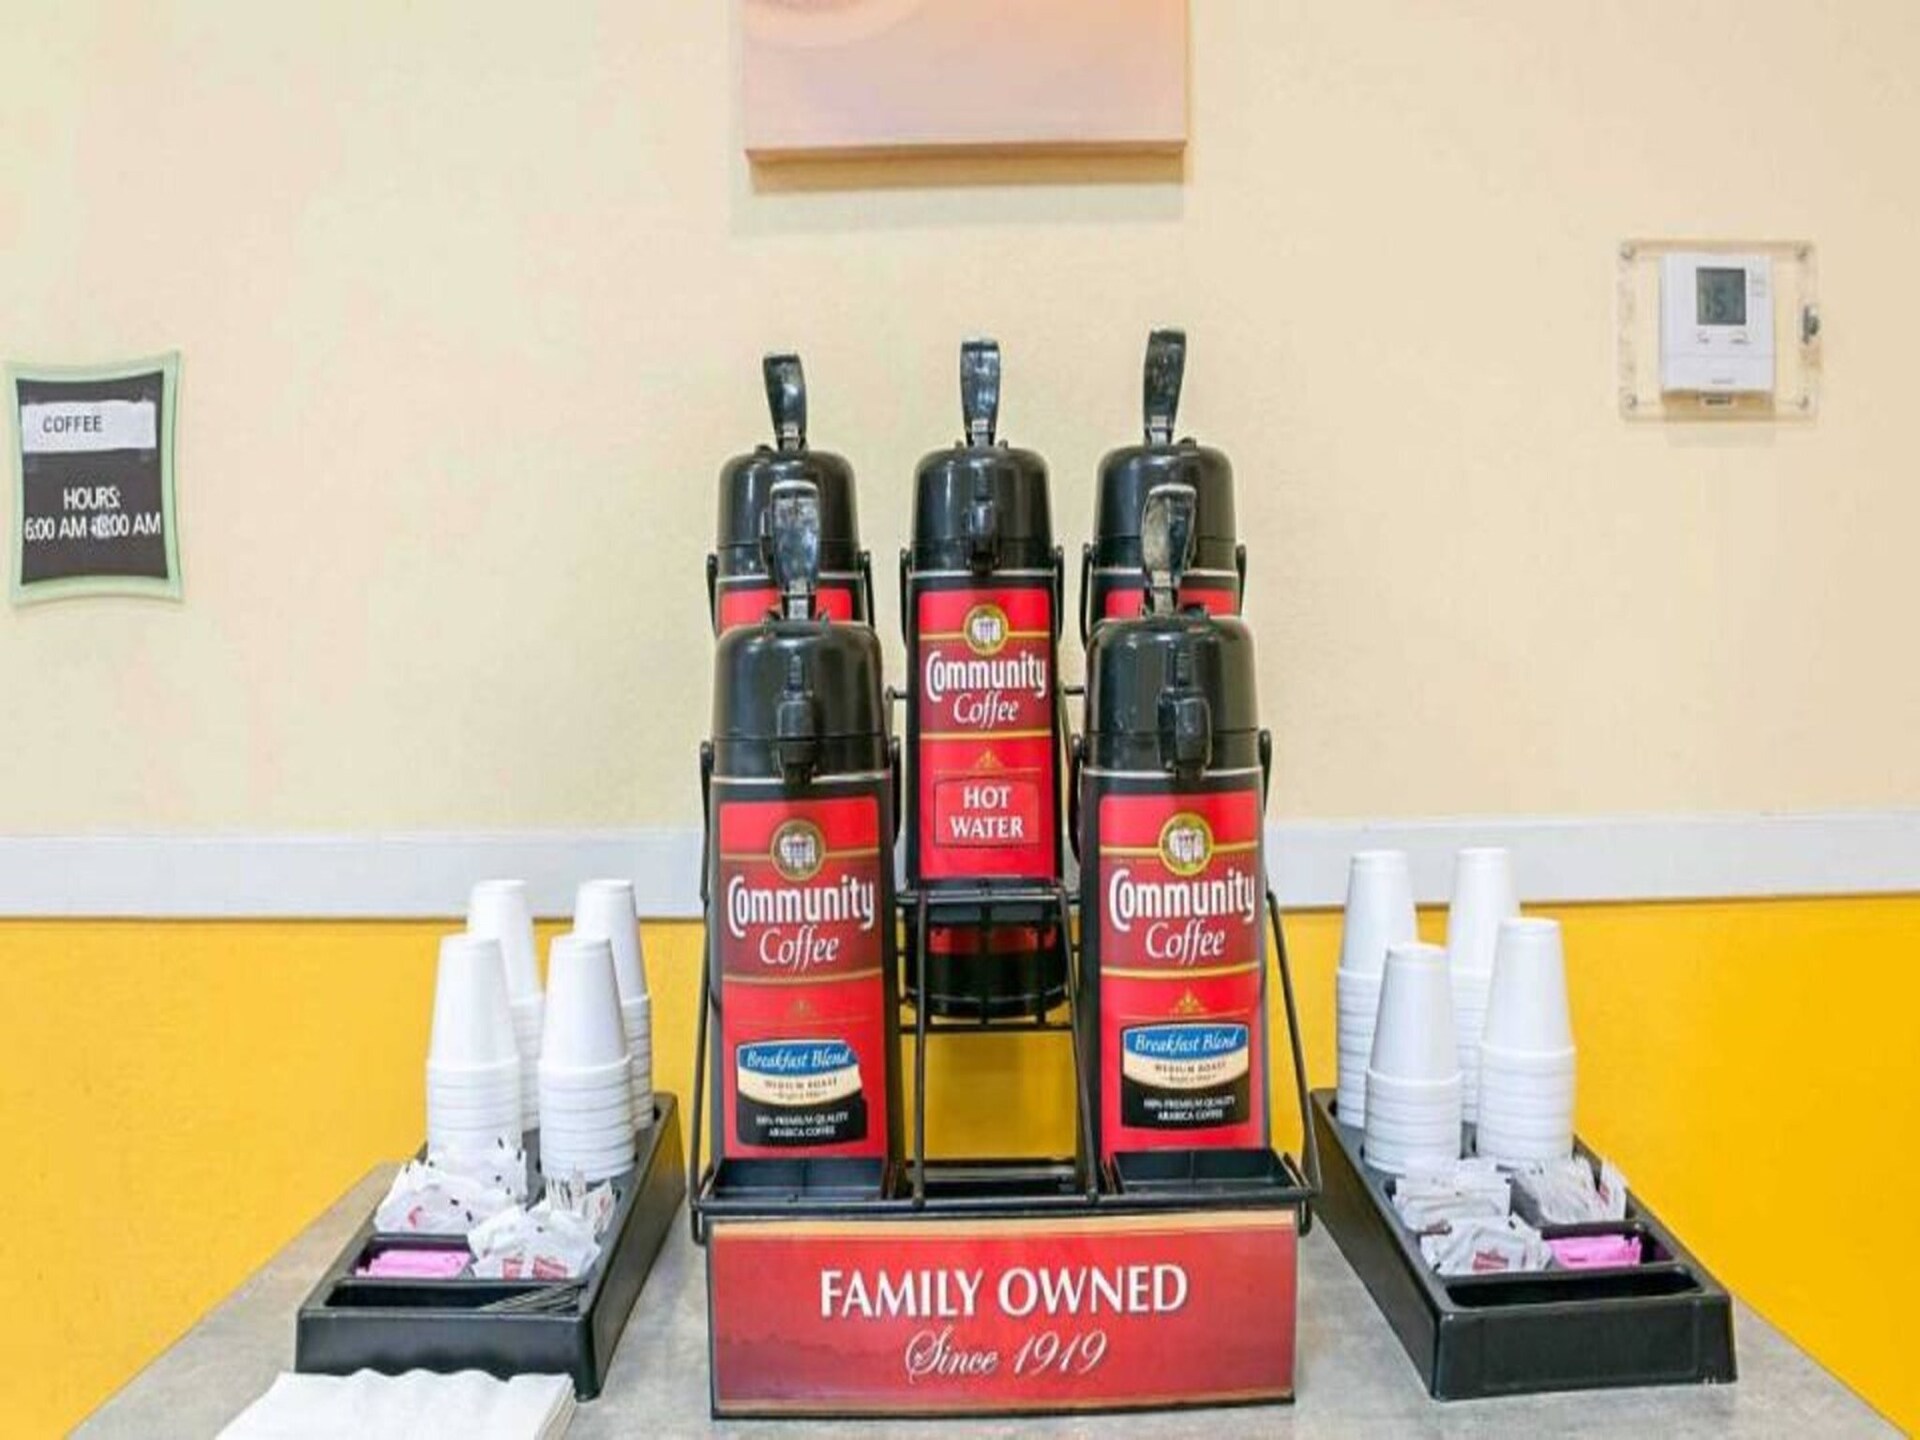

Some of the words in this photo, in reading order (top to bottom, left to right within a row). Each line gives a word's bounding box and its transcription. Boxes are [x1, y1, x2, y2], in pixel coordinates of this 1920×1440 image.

[43, 415, 103, 433] COFFEE
[63, 486, 121, 510] HOURS:
[25, 516, 55, 540] 6:00
[59, 515, 87, 539] AM
[132, 511, 161, 535] AM
[926, 650, 1046, 701] Community
[953, 690, 1019, 729] Coffee
[963, 786, 1011, 808] HOT
[950, 816, 1023, 838] WATER
[727, 874, 875, 938] Community
[1109, 868, 1255, 932] Community
[759, 923, 839, 971] Coffee
[1145, 918, 1225, 966] Coffee
[746, 1047, 808, 1072] Breakfast
[811, 1047, 849, 1068] Blend
[1135, 1033, 1201, 1056] Breakfast
[1203, 1028, 1239, 1051] Blend
[820, 1268, 984, 1318] FAMILY
[997, 1264, 1188, 1317] OWNED
[904, 1324, 998, 1385] Since
[1013, 1330, 1108, 1376] 1919
